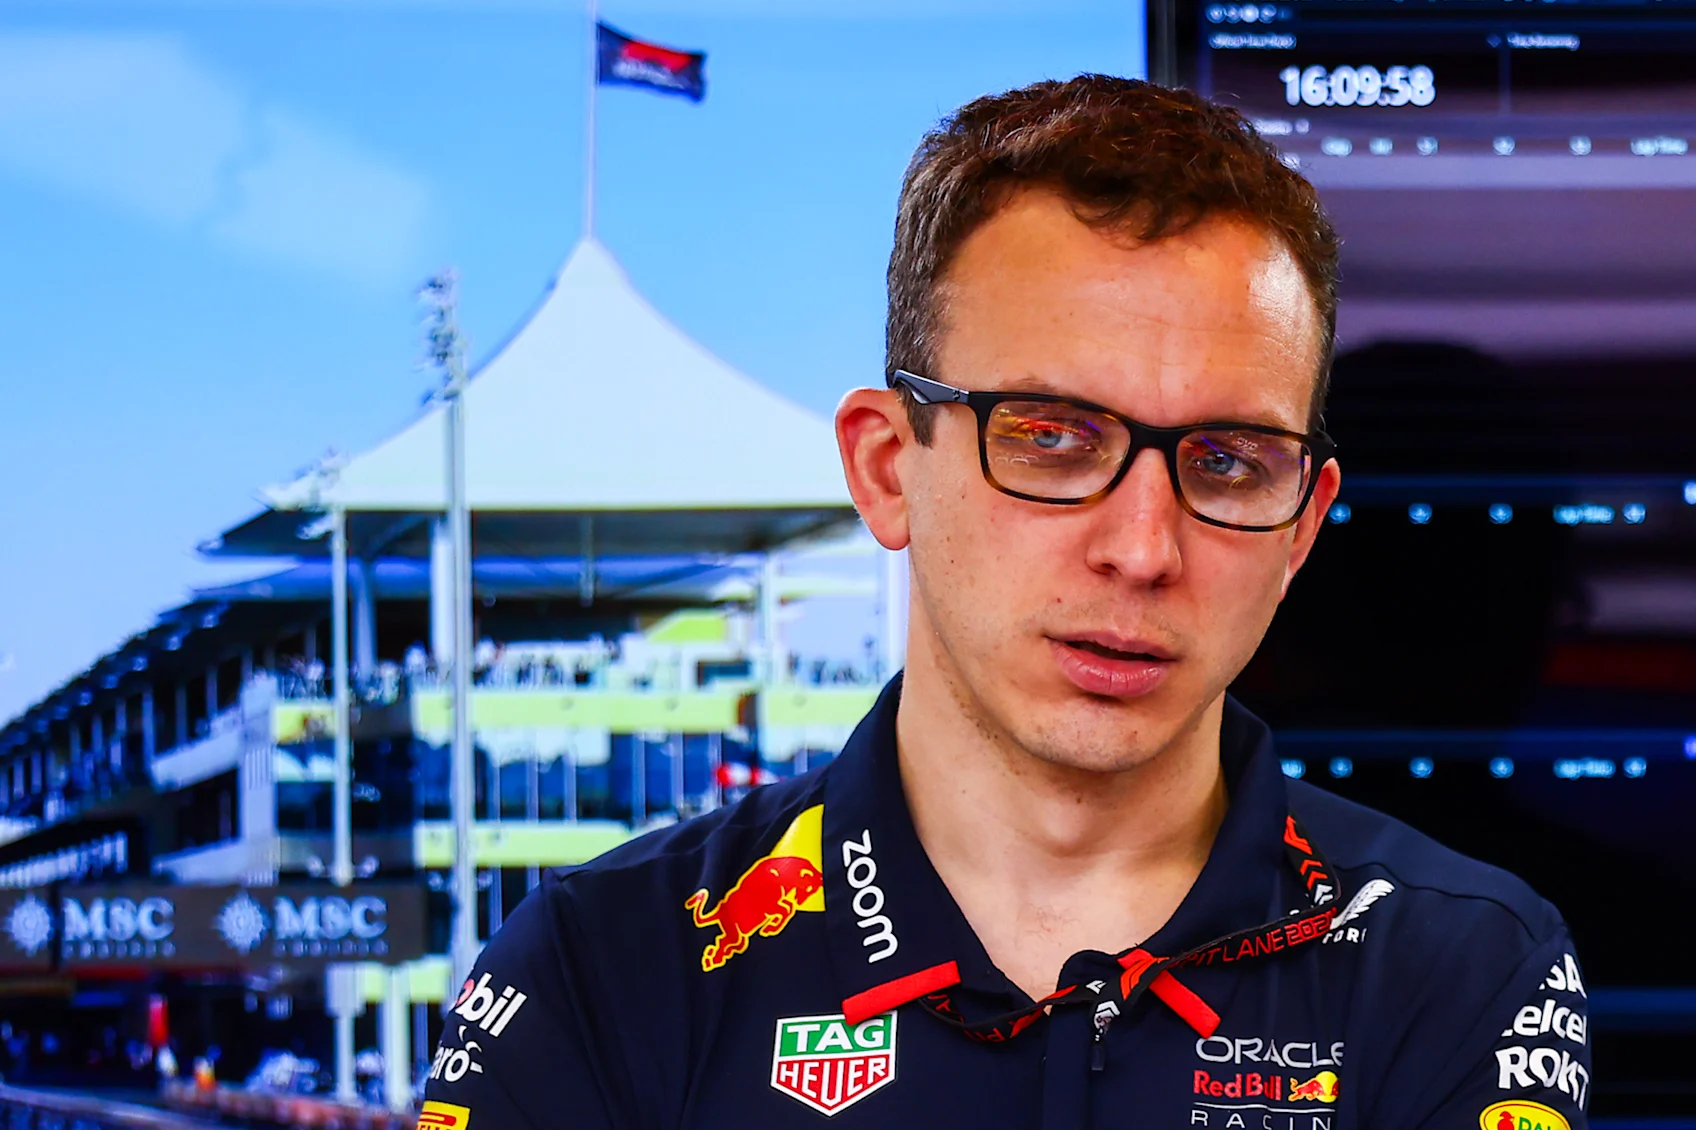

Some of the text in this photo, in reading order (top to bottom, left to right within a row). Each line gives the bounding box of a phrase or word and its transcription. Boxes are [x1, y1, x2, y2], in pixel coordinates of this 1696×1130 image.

[1279, 64, 1436, 106] 16:09:58
[274, 897, 388, 939] MSC
[842, 829, 898, 963] zoom
[62, 897, 175, 941] MSC
[1222, 928, 1285, 962] LANE
[1283, 906, 1337, 947] 202
[455, 972, 528, 1038] obil
[786, 1018, 885, 1053] TAG
[1196, 1035, 1344, 1068] ORACLE
[779, 1057, 887, 1106] HEUER
